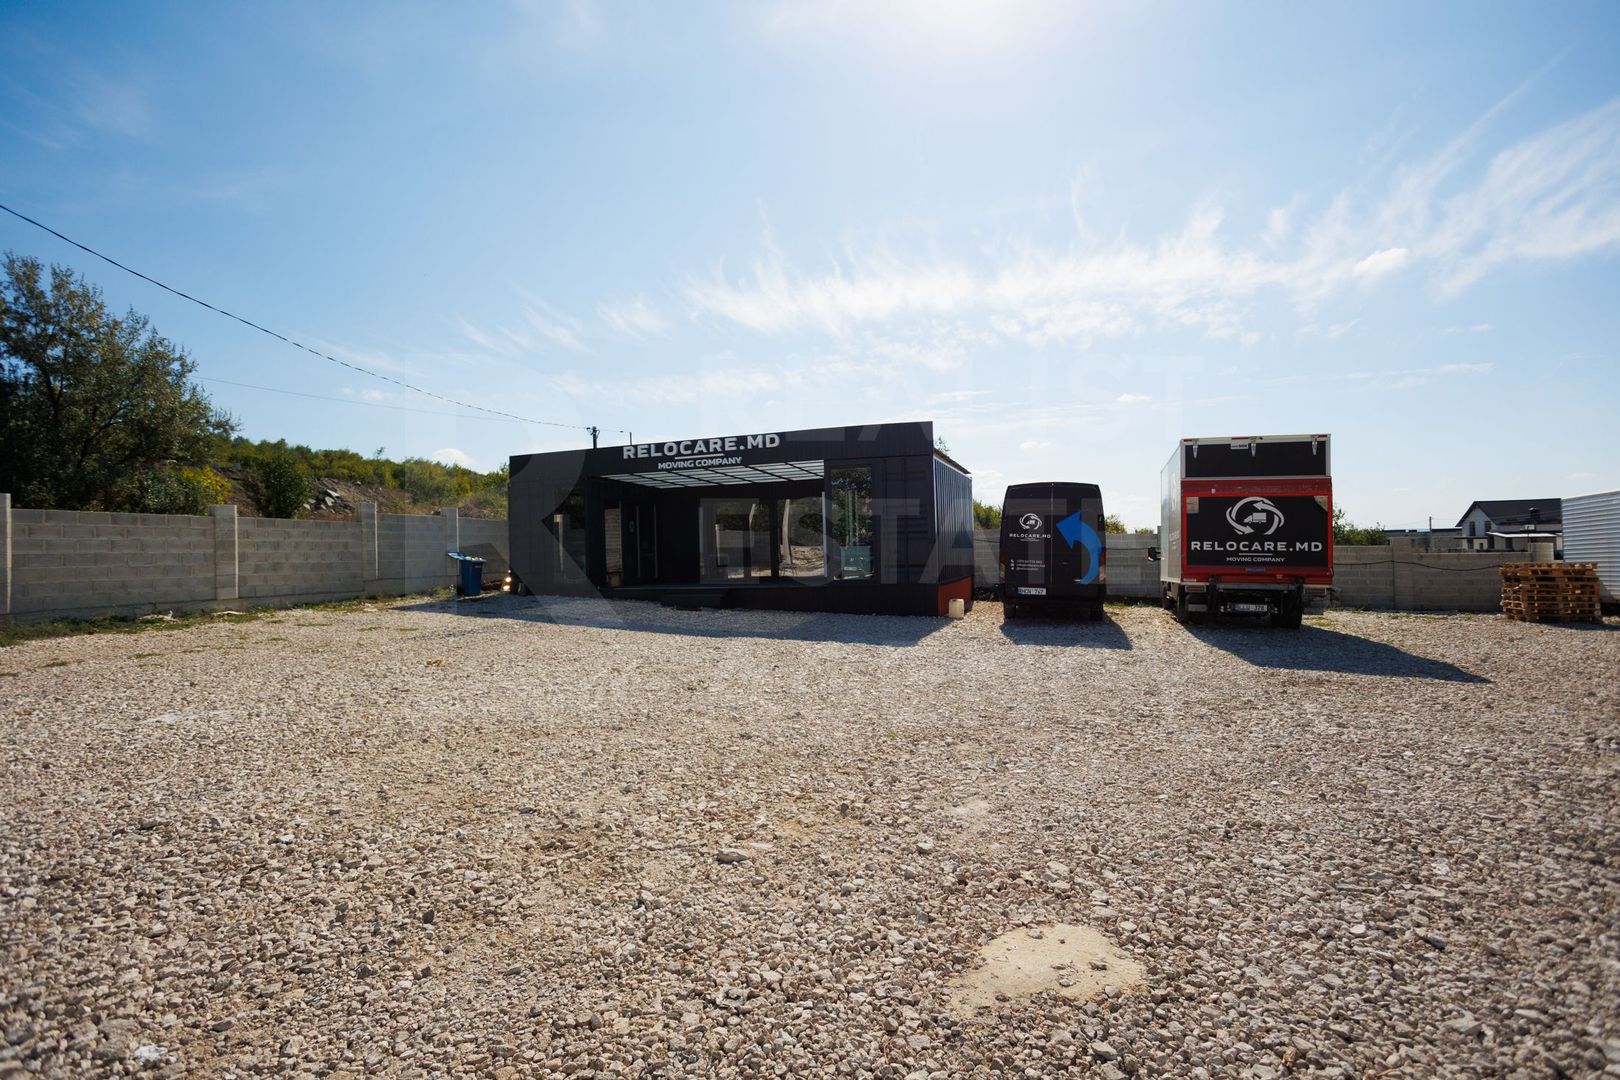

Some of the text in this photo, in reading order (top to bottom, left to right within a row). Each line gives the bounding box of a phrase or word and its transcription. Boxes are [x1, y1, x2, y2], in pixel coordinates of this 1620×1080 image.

[623, 433, 780, 459] RELOCARE.MD
[658, 456, 742, 470] MOVING COMPANY
[1191, 541, 1323, 552] RELOCARE.MD
